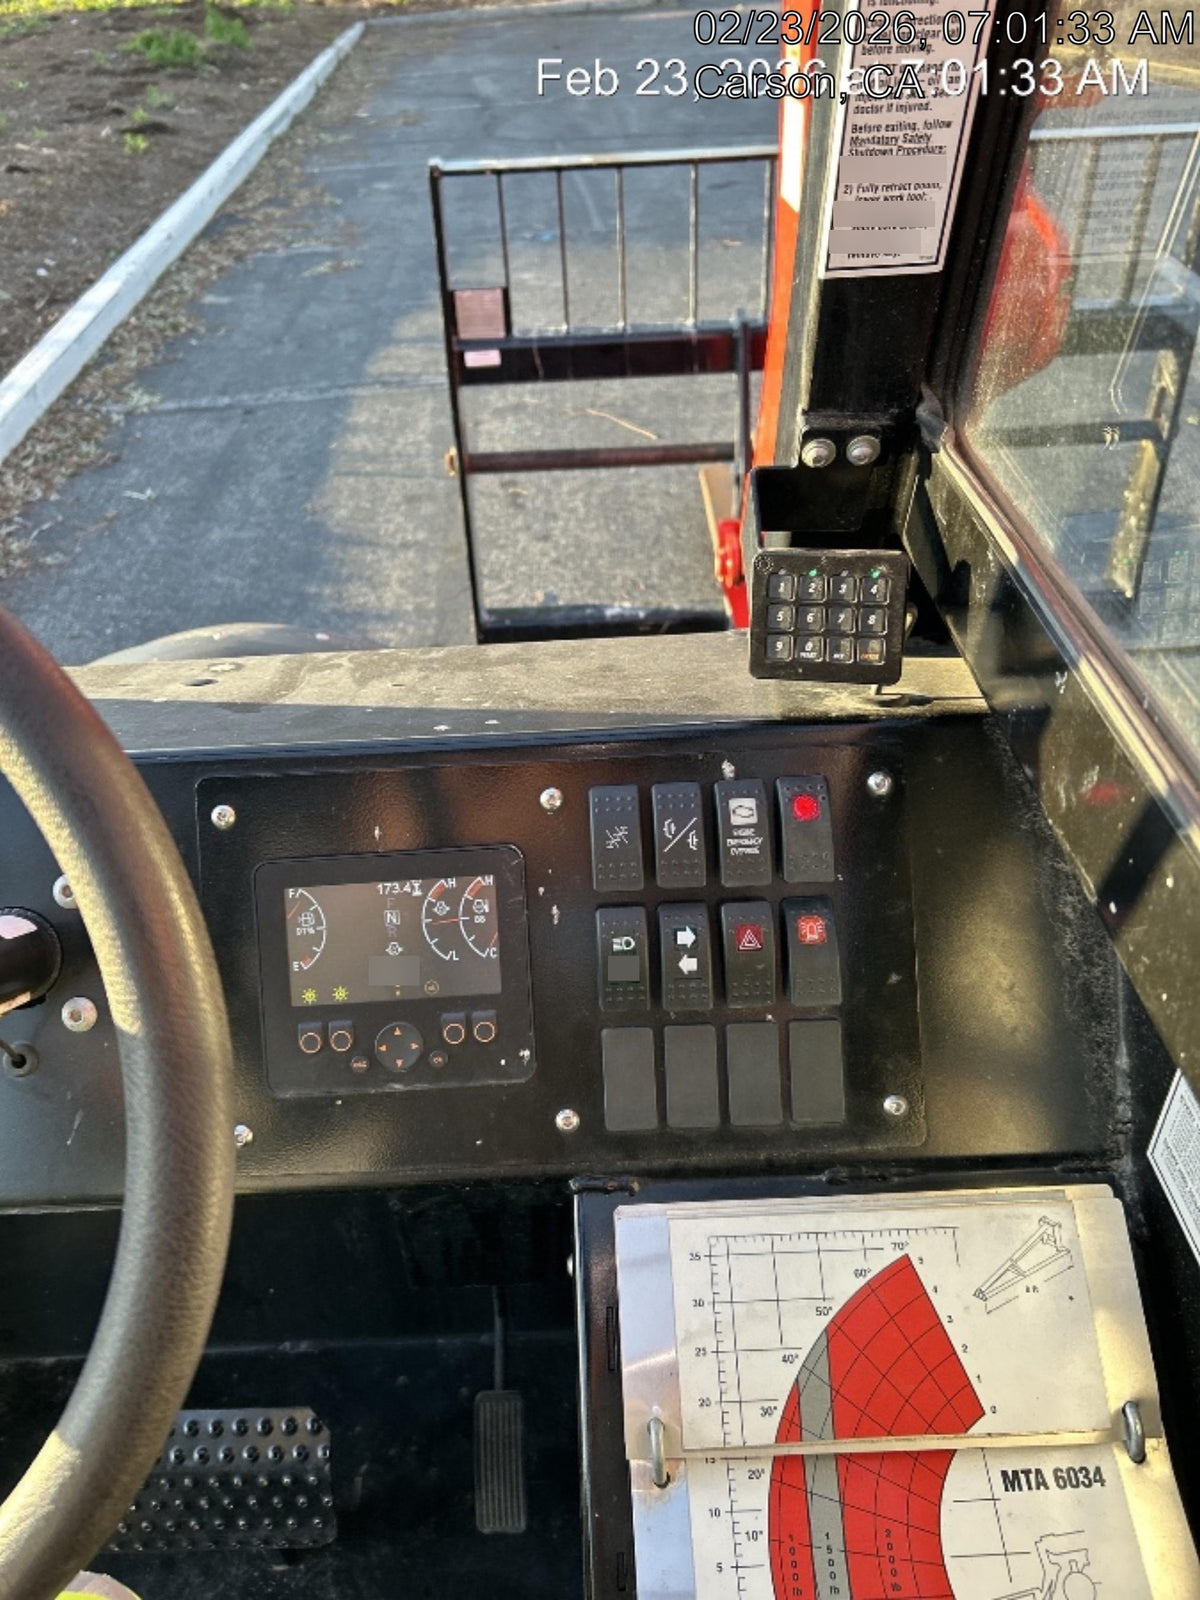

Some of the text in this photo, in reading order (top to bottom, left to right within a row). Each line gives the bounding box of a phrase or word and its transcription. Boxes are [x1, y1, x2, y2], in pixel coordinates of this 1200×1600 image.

[851, 123, 883, 134] Before
[923, 119, 952, 130] follow
[849, 134, 900, 147] Mandatory
[778, 582, 785, 592] 1
[808, 582, 816, 593] 2
[839, 583, 847, 593] 3
[870, 584, 878, 594] 4
[776, 611, 783, 621] 5
[806, 612, 814, 623] 6
[837, 613, 845, 624] 7
[867, 614, 877, 625] 8
[776, 641, 783, 651] 9
[805, 641, 813, 651] 0
[447, 877, 456, 888] H
[484, 875, 493, 886] H
[289, 888, 295, 898] F
[376, 881, 411, 896] 173.4
[453, 950, 460, 961] L
[490, 949, 497, 959] C
[293, 961, 299, 971] E
[815, 1306, 833, 1316] 50°
[947, 1315, 953, 1323] 3
[695, 1347, 707, 1357] 25
[961, 1344, 968, 1353] 2
[782, 1354, 799, 1364] 40°
[698, 1398, 711, 1407] 20
[760, 1406, 778, 1417] 30°
[990, 1405, 997, 1414] 0
[748, 1468, 765, 1480] 20°
[1001, 1465, 1107, 1492] MTA 6034
[709, 1507, 721, 1518] 10
[745, 1530, 763, 1542] 10°
[716, 1562, 723, 1573] 5
